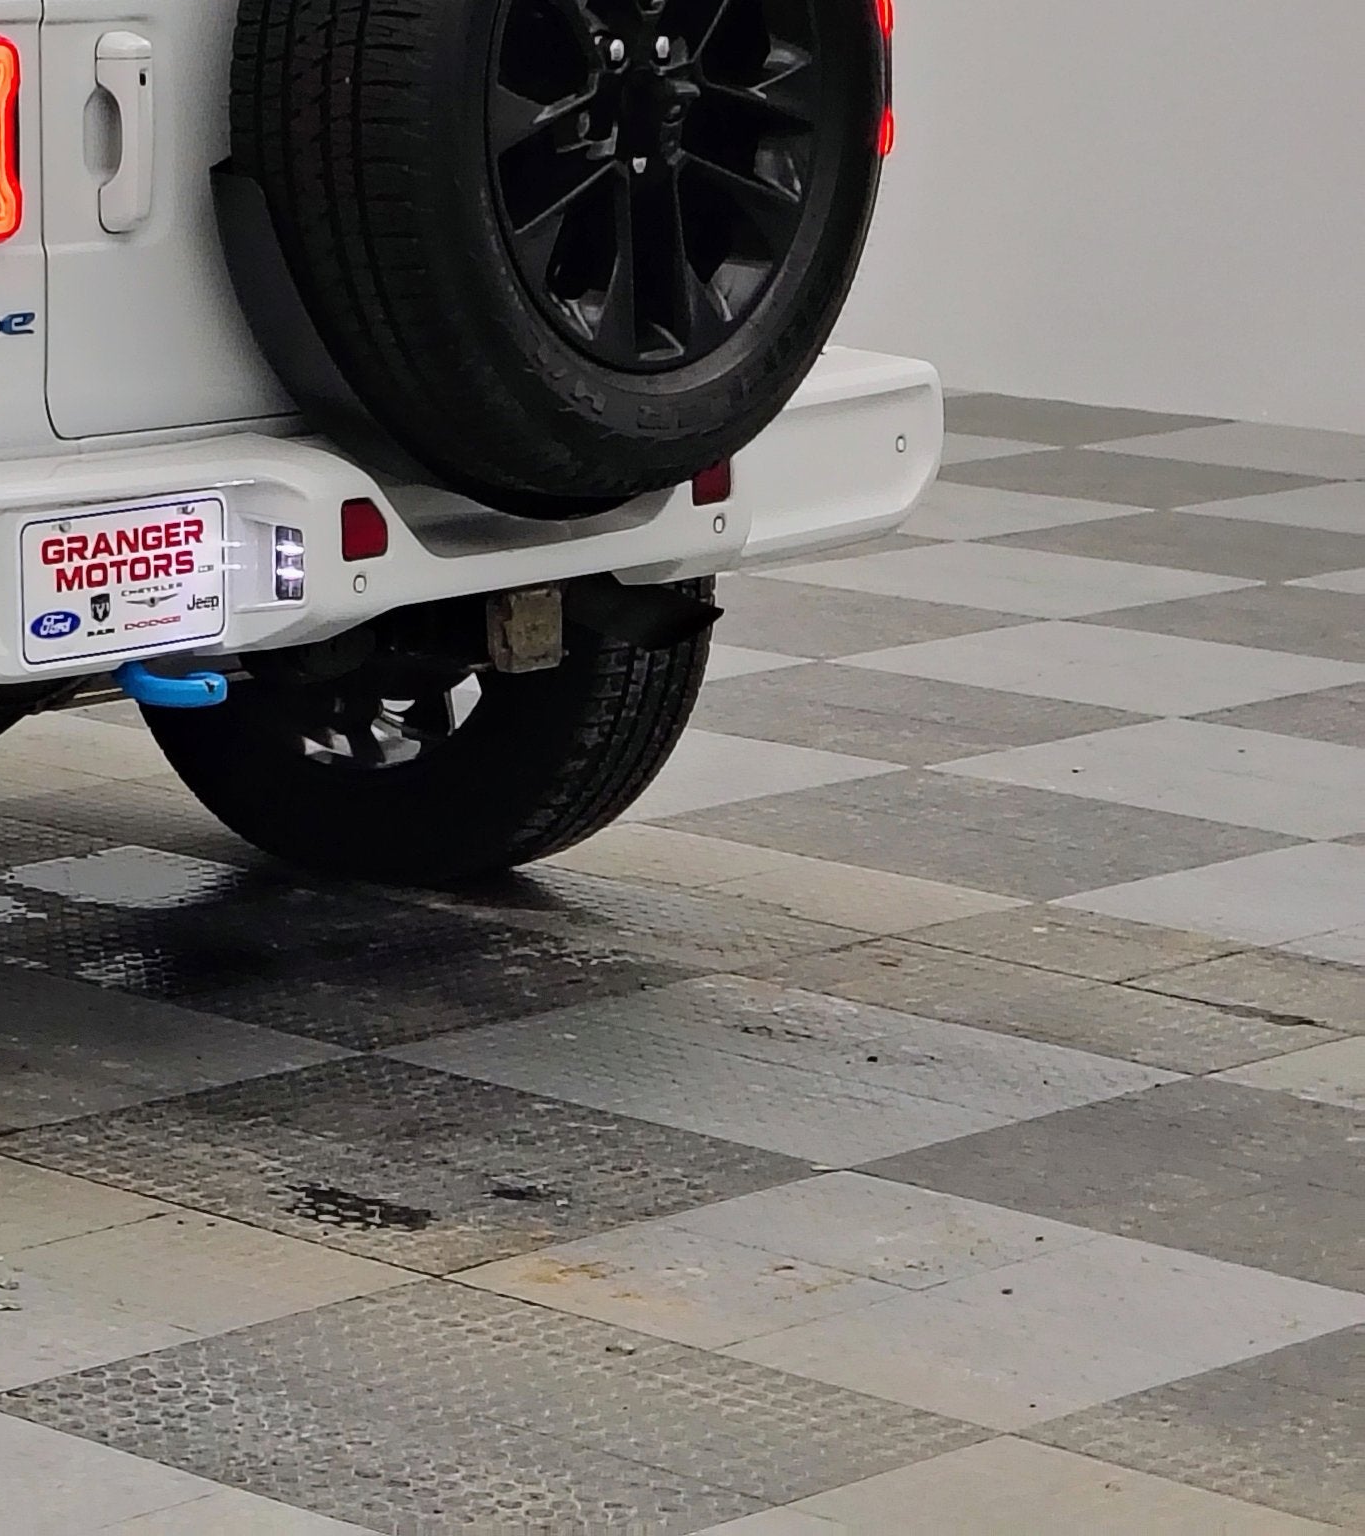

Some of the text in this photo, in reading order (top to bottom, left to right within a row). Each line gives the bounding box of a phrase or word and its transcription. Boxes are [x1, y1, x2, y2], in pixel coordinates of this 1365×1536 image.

[41, 519, 204, 565] GRANGER
[56, 550, 194, 593] MOTORS
[186, 593, 219, 611] Jeep
